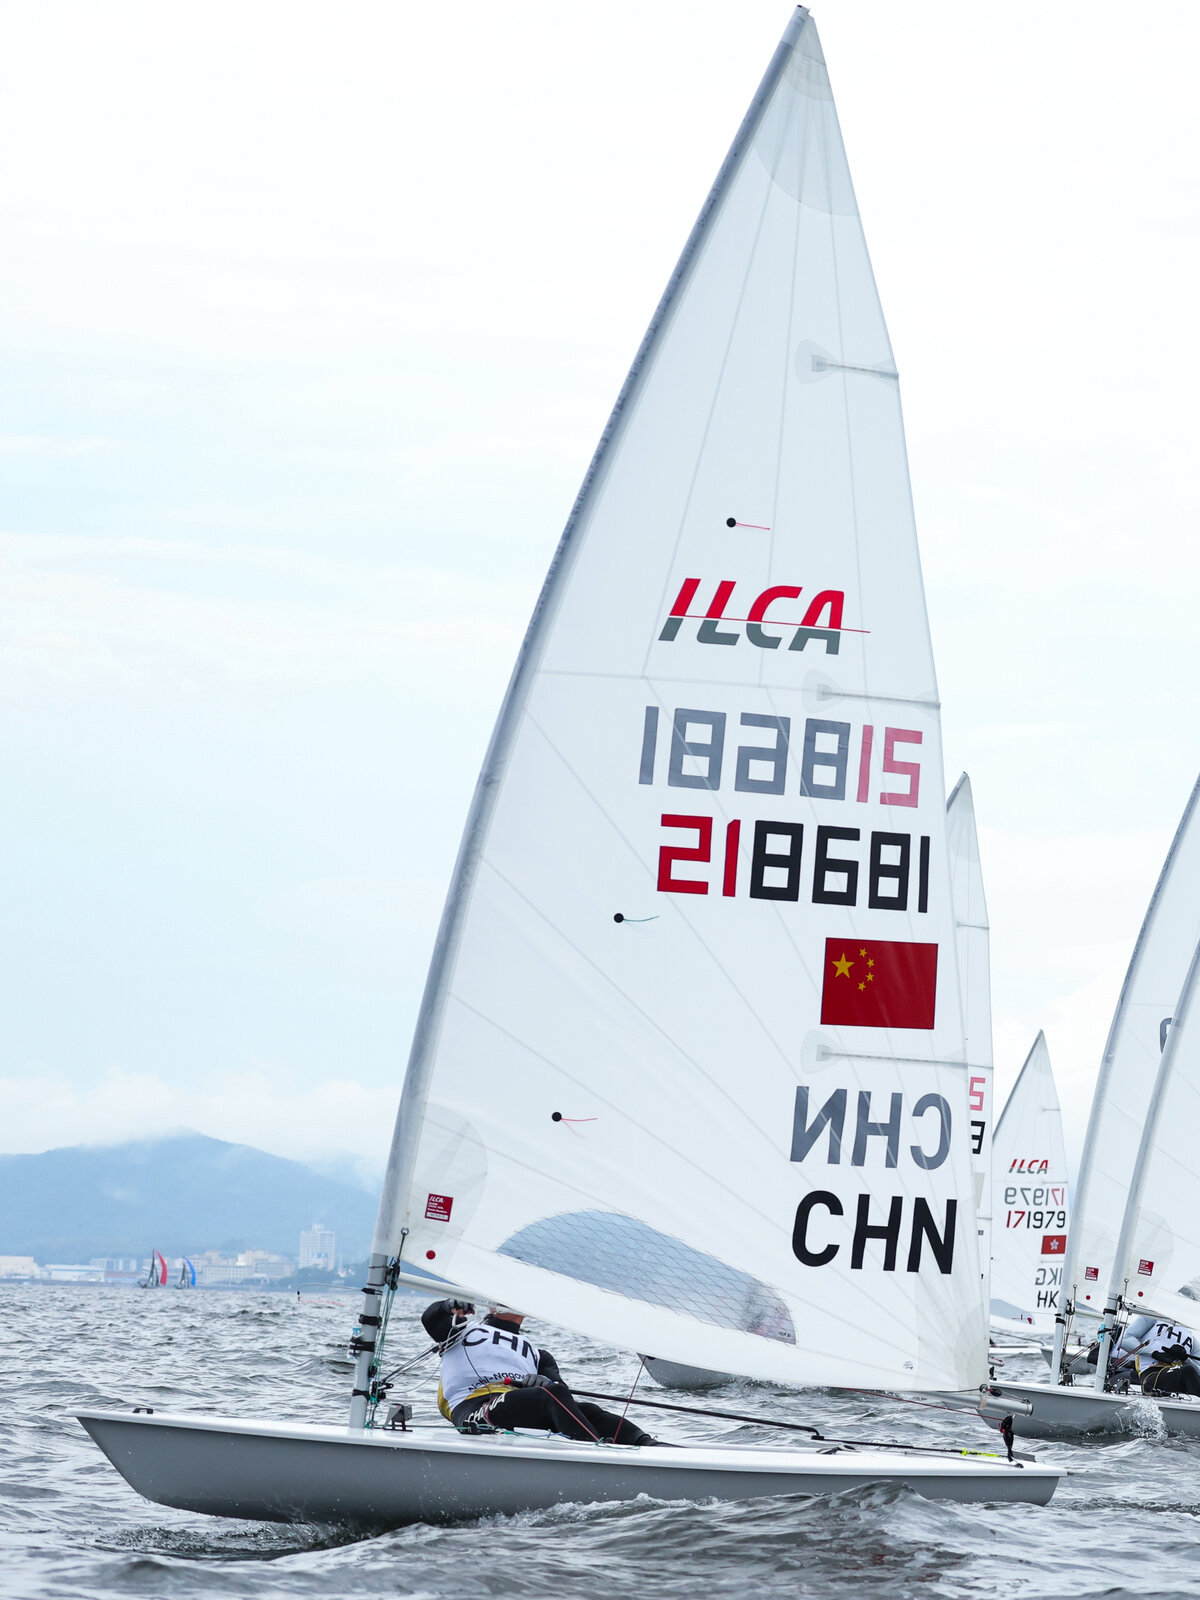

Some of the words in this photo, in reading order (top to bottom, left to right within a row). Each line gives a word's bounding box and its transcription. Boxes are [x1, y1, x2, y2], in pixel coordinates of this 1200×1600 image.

[658, 578, 845, 655] ILCA
[657, 814, 930, 912] 218681
[1008, 1158, 1049, 1174] ILCA
[792, 1190, 957, 1274] CHN
[1006, 1210, 1066, 1229] 171979
[1037, 1290, 1059, 1308] HK
[462, 1328, 538, 1370] CHN
[1156, 1323, 1193, 1350] THA
